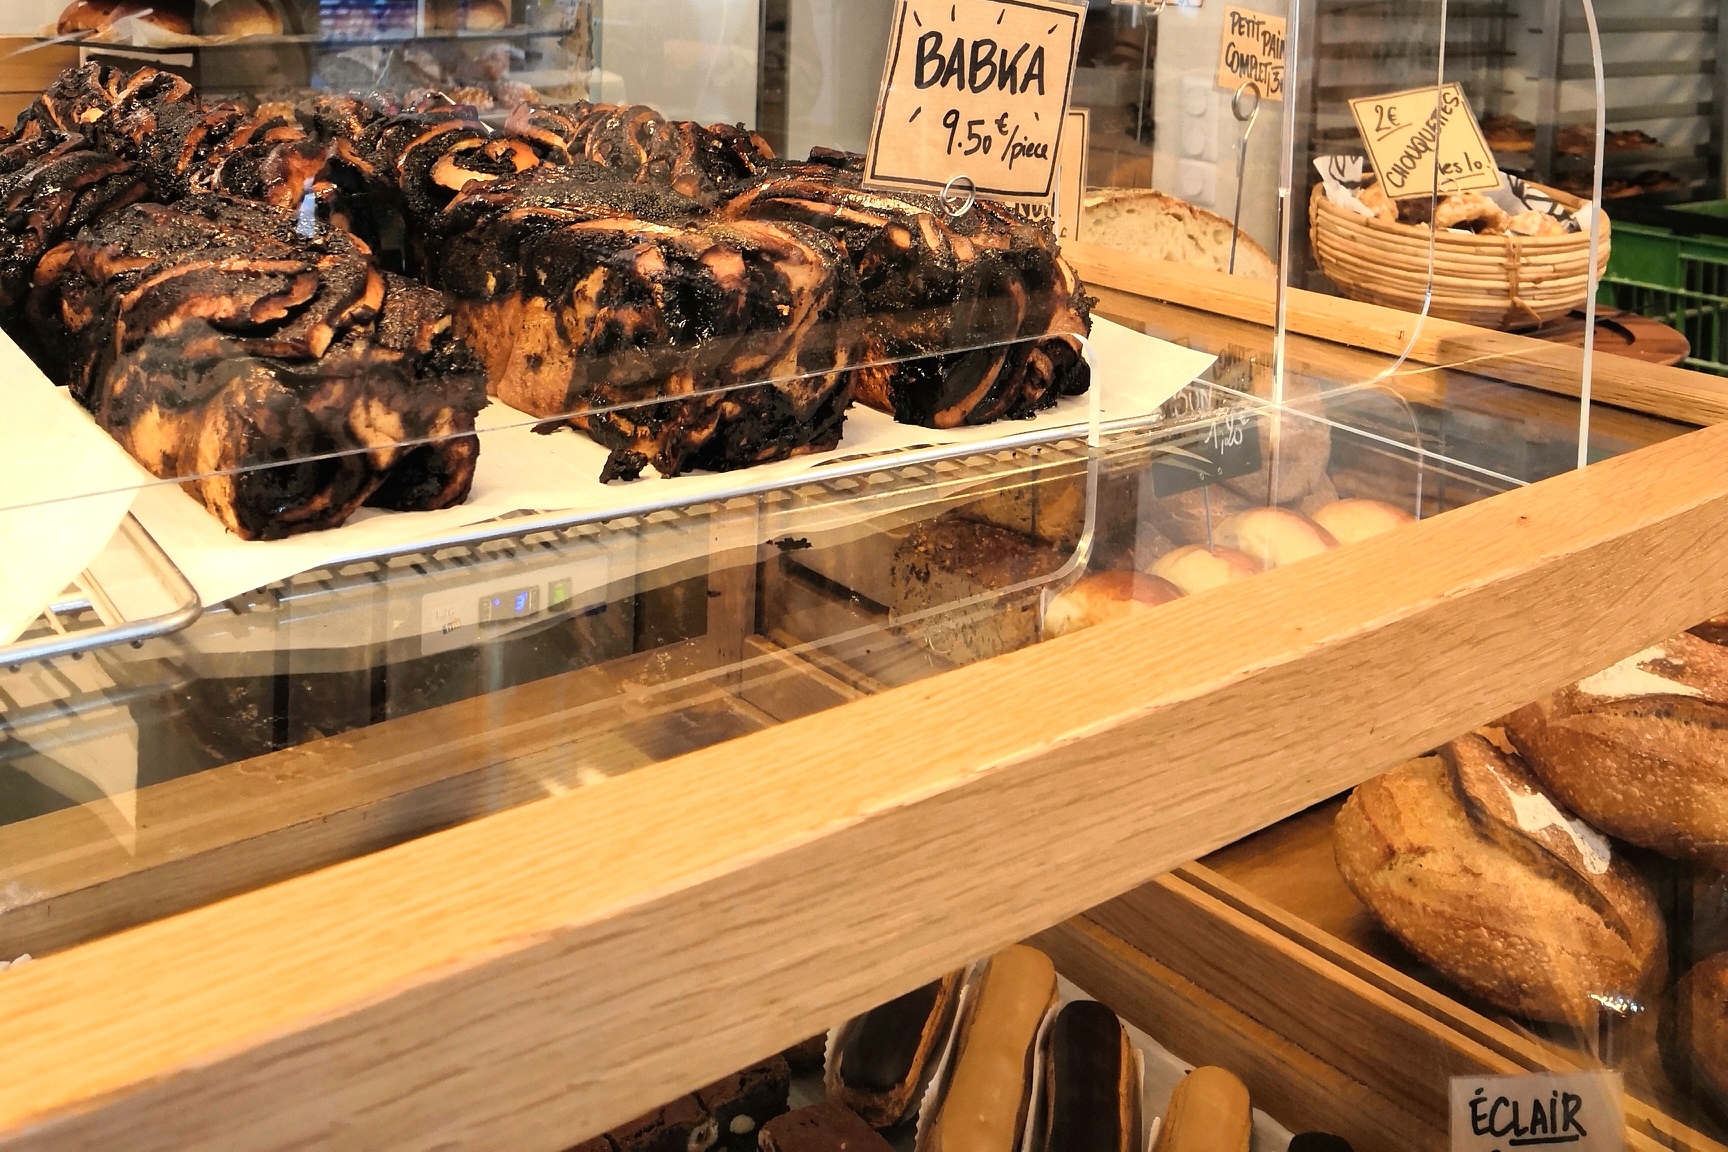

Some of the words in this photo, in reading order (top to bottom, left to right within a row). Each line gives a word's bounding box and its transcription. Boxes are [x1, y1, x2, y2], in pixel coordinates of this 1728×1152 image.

[1230, 10, 1265, 42] PETiT
[914, 30, 1046, 96] BABKA
[1374, 104, 1401, 133] 2€
[1469, 1087, 1587, 1137] ÉCLAiR
